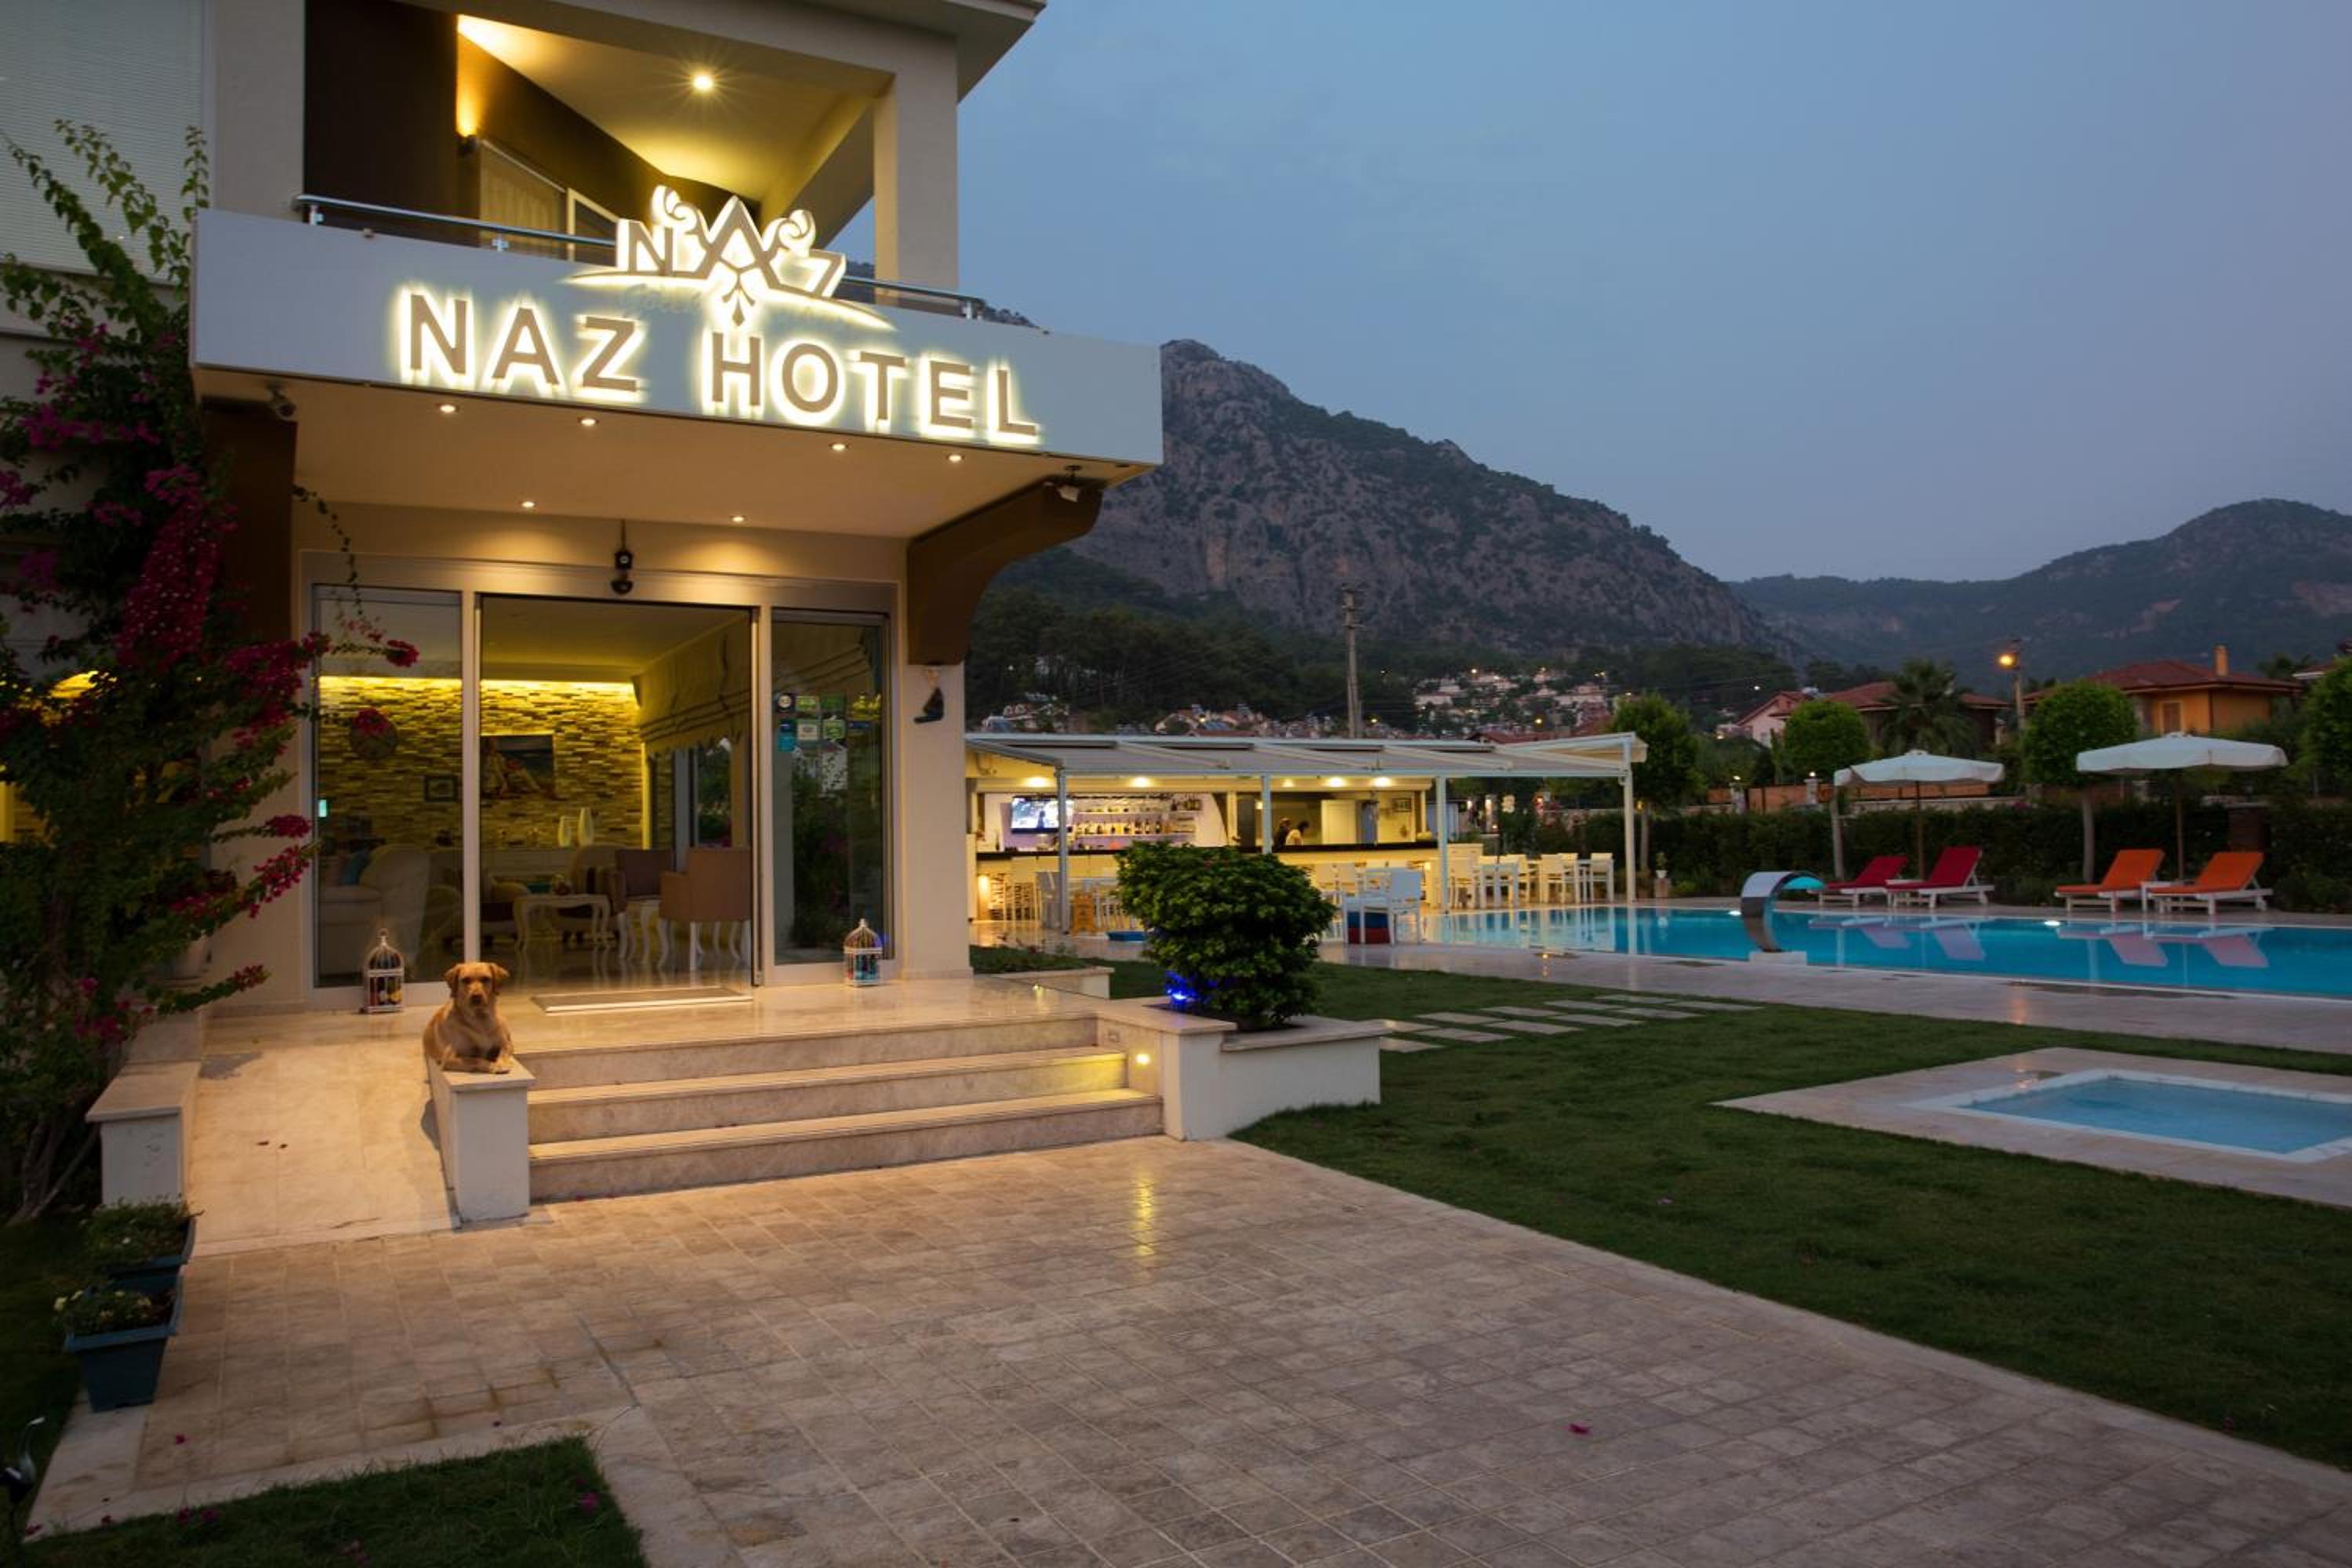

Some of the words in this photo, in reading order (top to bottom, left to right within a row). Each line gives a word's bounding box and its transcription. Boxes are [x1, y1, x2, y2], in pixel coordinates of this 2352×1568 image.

[626, 194, 846, 298] NAZ
[409, 293, 637, 393] NAZ
[711, 331, 1037, 437] HOTEL
